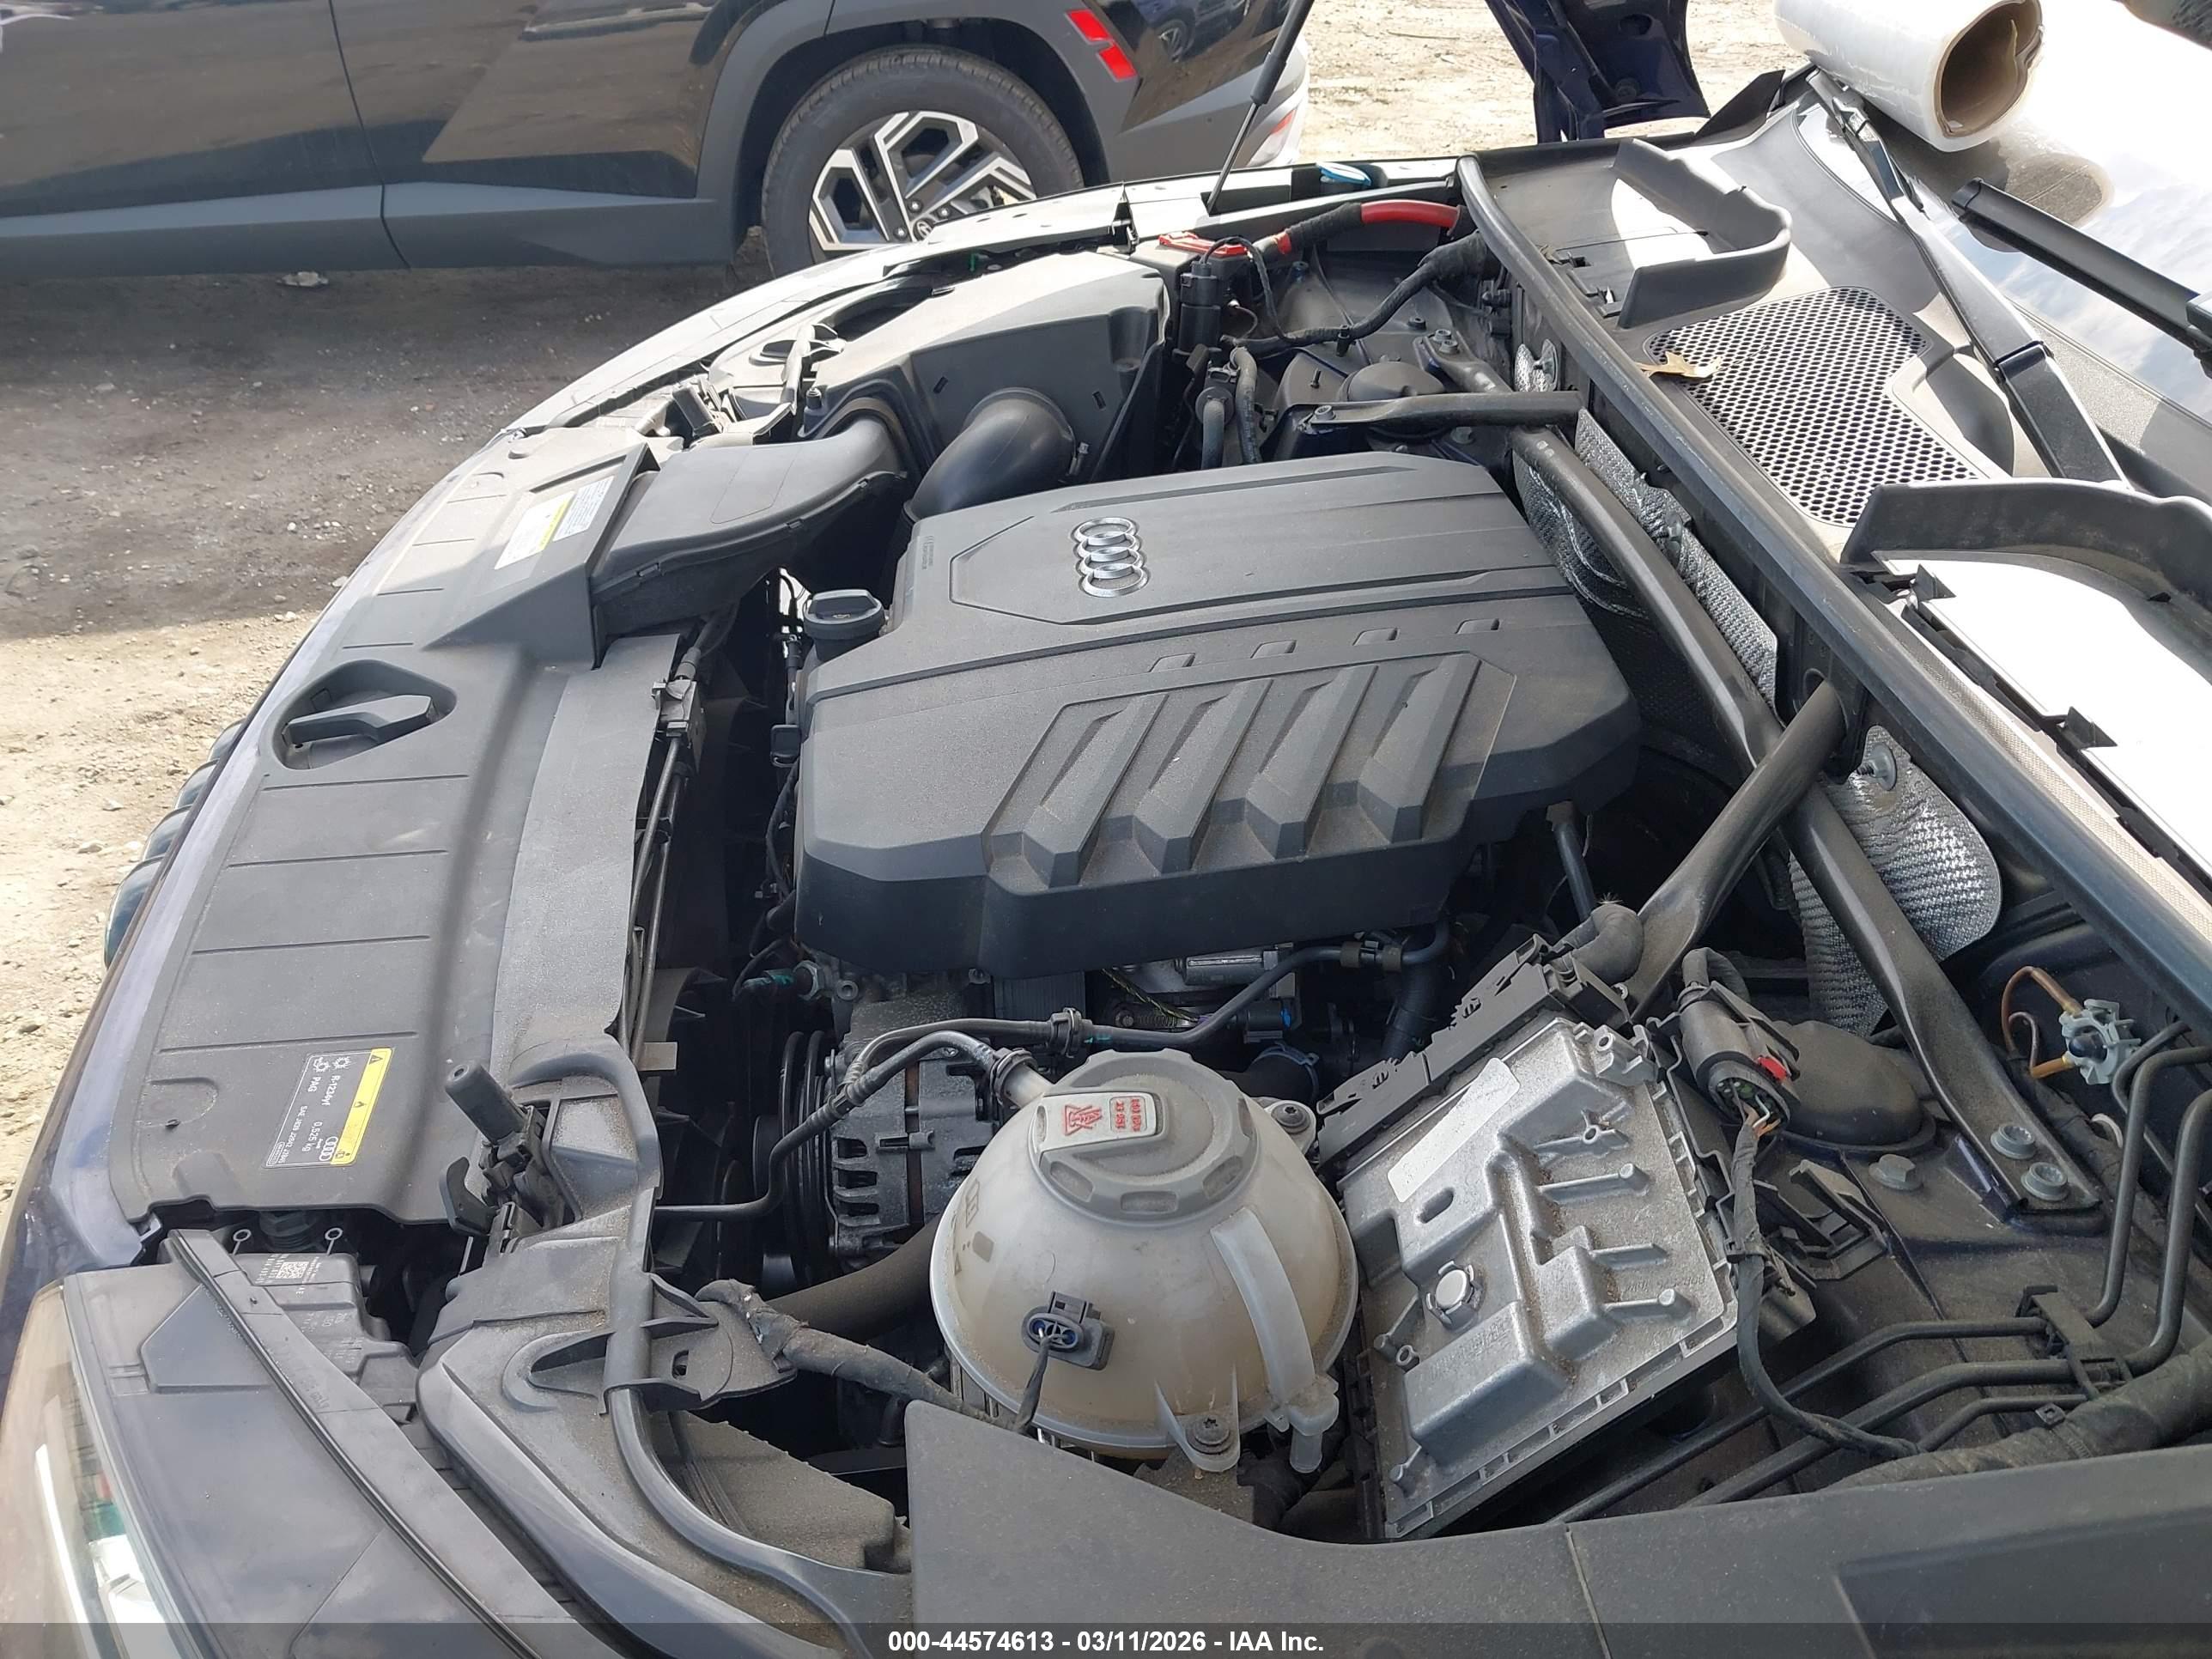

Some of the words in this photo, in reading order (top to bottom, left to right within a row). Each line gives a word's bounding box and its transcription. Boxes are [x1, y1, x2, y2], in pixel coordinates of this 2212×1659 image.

[307, 1076, 321, 1092] PAG
[321, 1075, 341, 1106] R-1234yf
[297, 1105, 308, 1117] SAE
[308, 1121, 323, 1141] 0,525
[301, 1143, 316, 1152] kg
